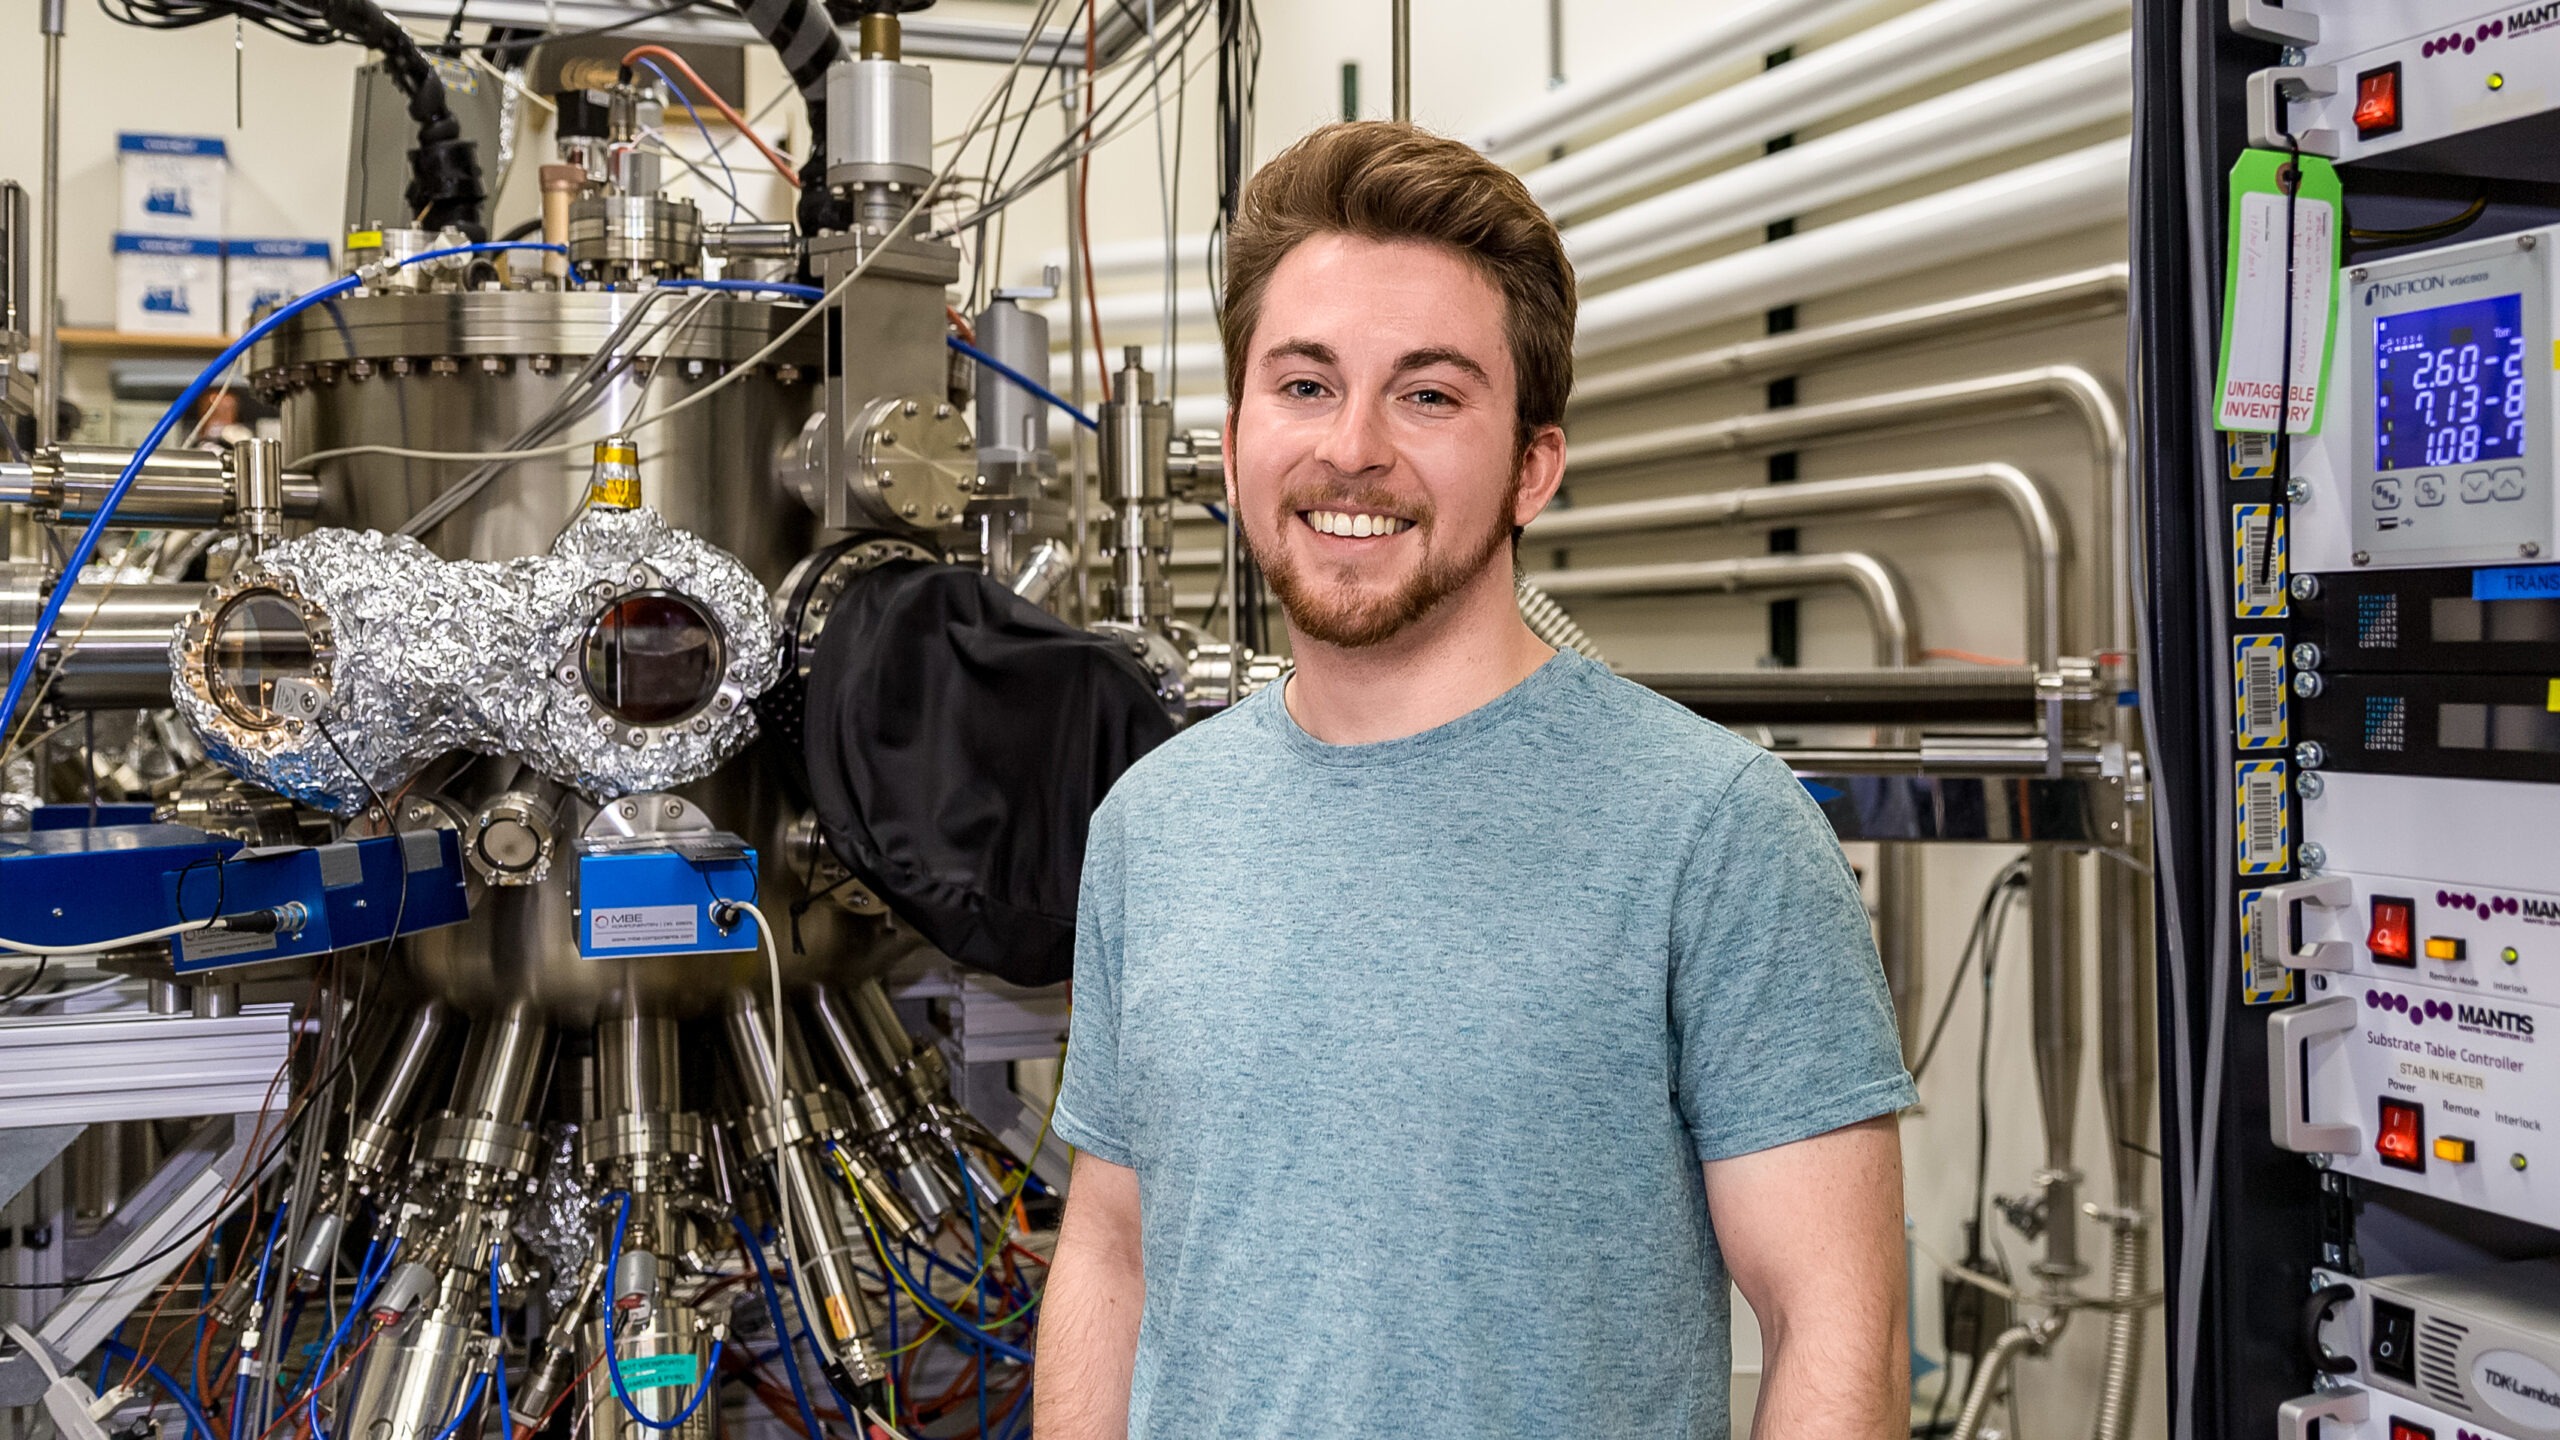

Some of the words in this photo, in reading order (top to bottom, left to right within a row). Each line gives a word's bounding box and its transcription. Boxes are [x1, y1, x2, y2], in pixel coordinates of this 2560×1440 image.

[2381, 275, 2444, 298] INFICON
[2227, 381, 2314, 402] UNTAGGBLE
[2224, 401, 2310, 421] INVENTRY
[2505, 574, 2560, 591] TRANS
[612, 913, 642, 923] MBE
[2429, 971, 2457, 984] Remote
[2459, 976, 2479, 987] Mode
[2458, 1004, 2534, 1035] MANTIS
[2367, 1030, 2421, 1054] Substrate
[2424, 1041, 2456, 1060] Table
[2460, 1048, 2524, 1072] Controller
[2388, 1078, 2416, 1093] Power
[2400, 1063, 2426, 1078] STAB
[2429, 1069, 2439, 1080] IN
[2442, 1071, 2484, 1089] HEATER
[2443, 1100, 2480, 1118] Remote
[2495, 1111, 2541, 1132] Interlock
